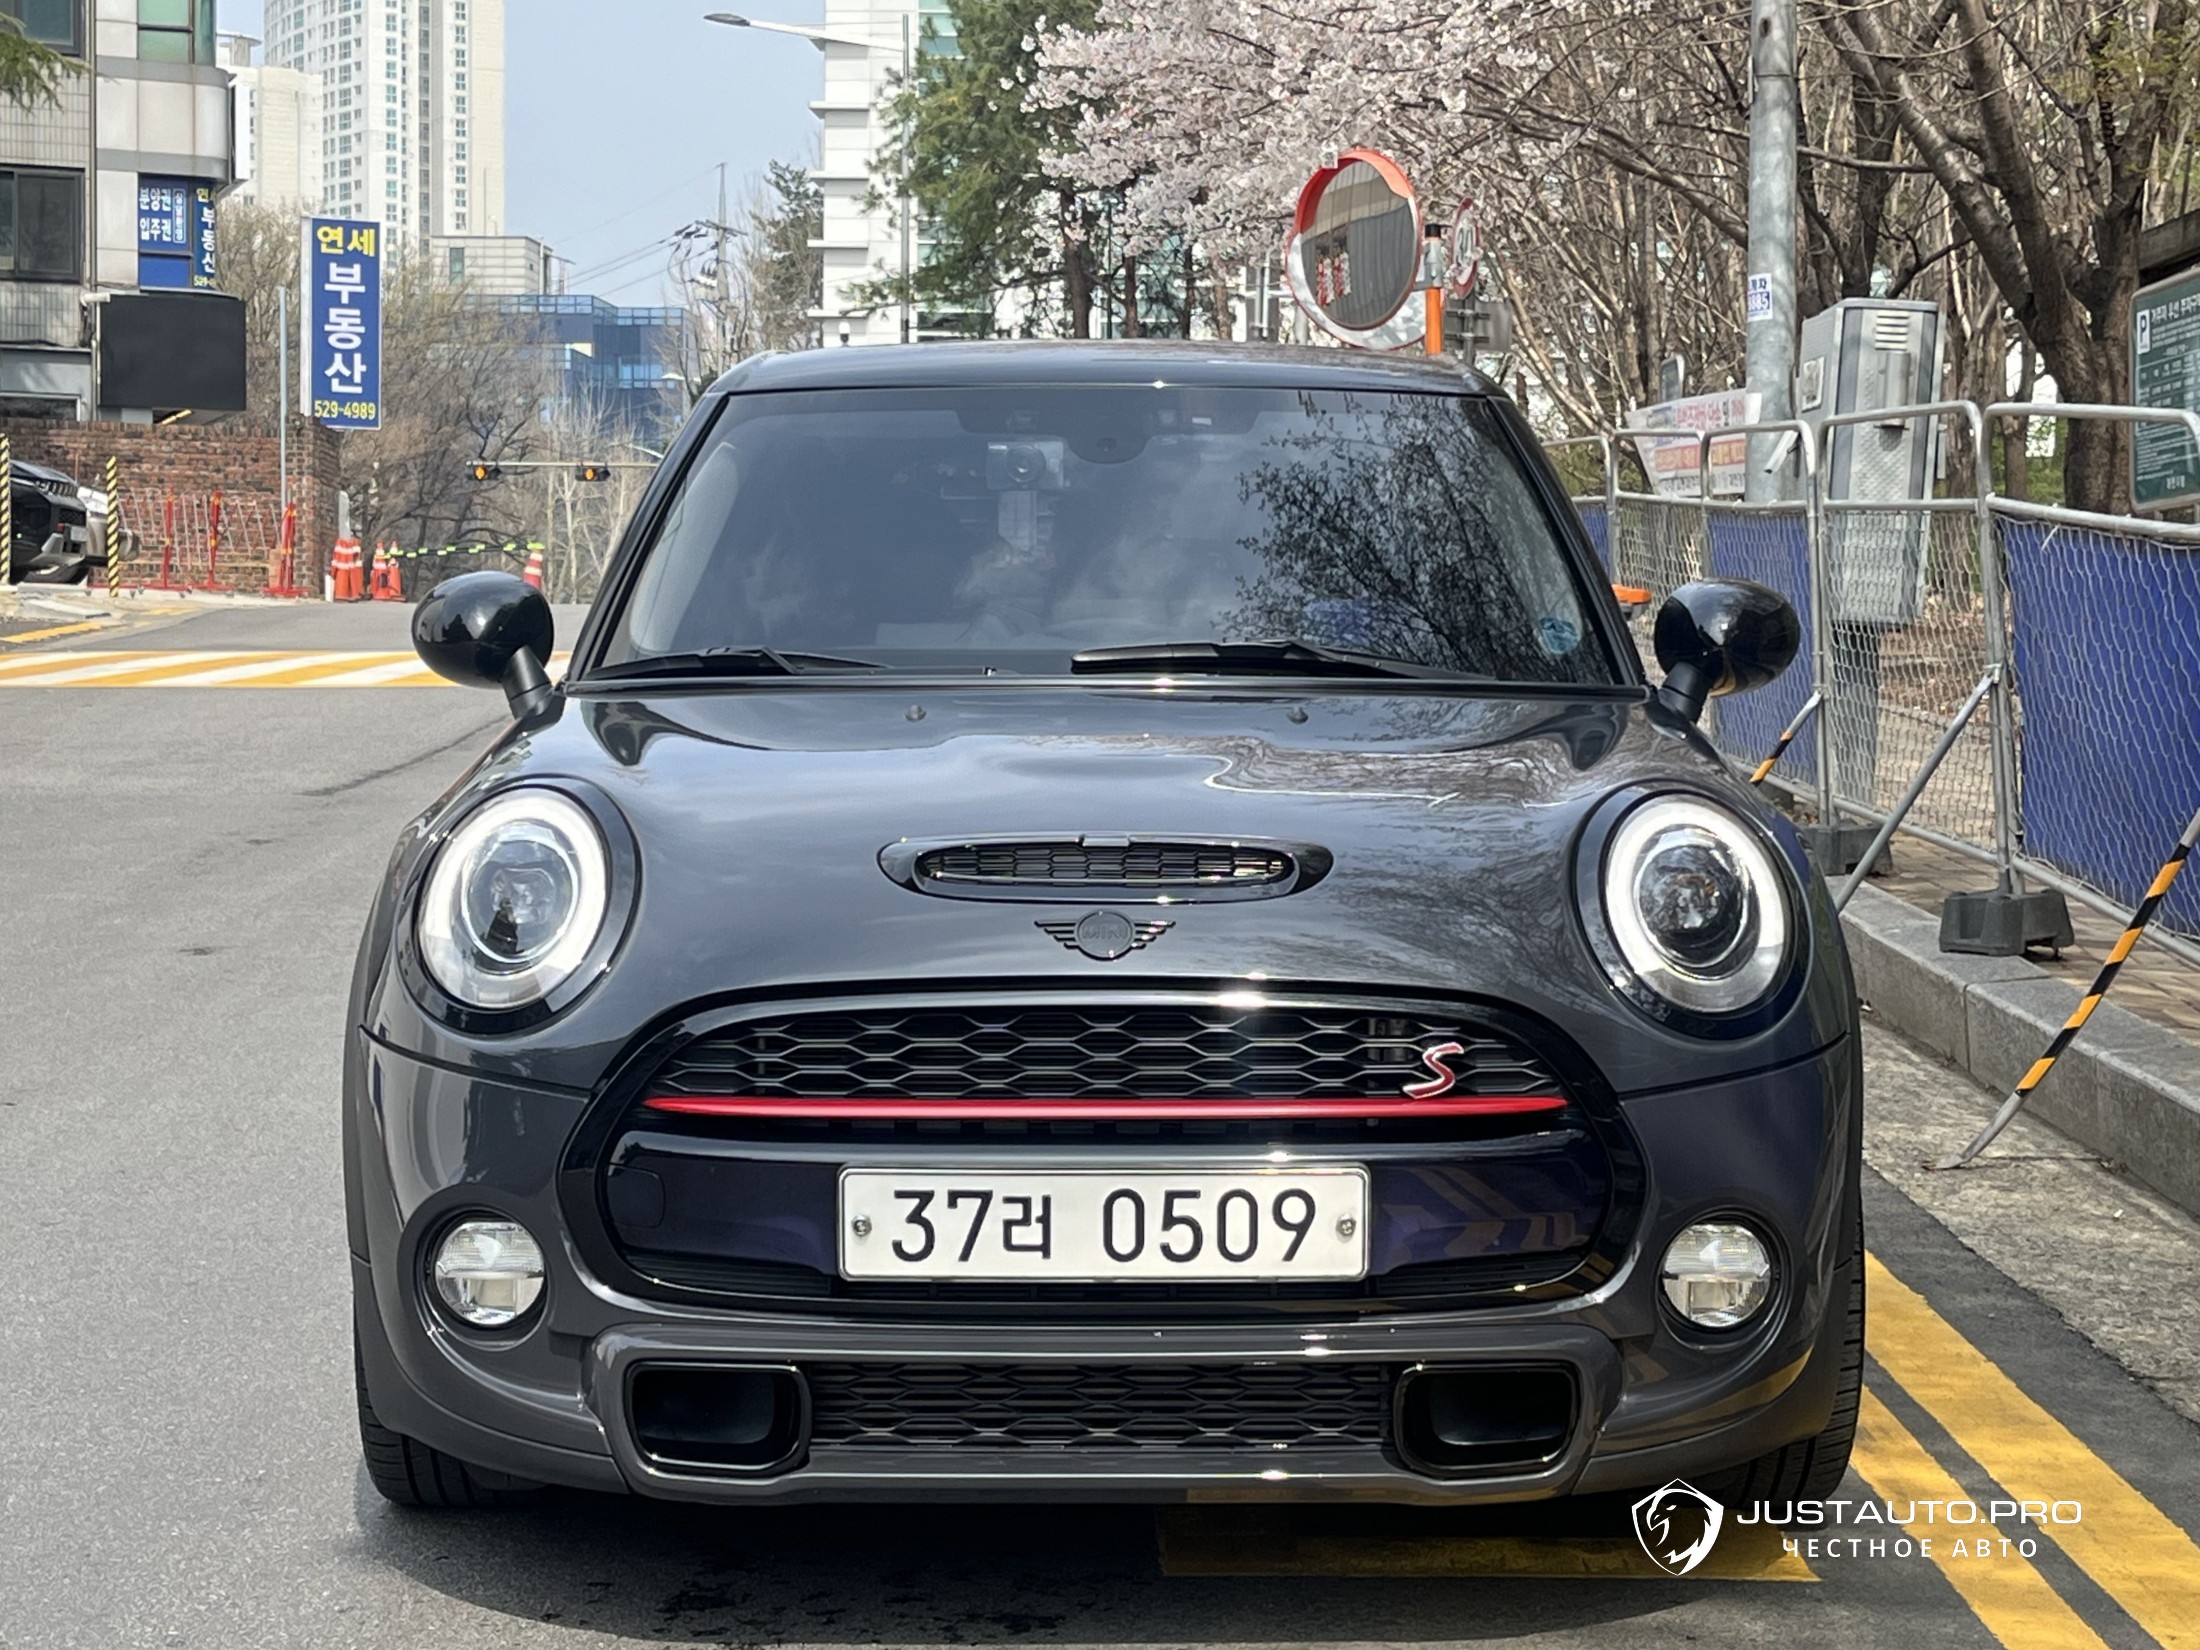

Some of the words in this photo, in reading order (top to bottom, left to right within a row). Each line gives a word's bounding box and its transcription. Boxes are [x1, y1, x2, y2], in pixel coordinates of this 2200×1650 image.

[139, 187, 171, 211] 분양권
[139, 217, 172, 242] 입주권
[316, 225, 376, 257] 연세
[323, 262, 367, 394] 부동산
[314, 400, 376, 420] 529-4989
[1082, 926, 1129, 939] MINI
[1402, 1042, 1464, 1099] S
[892, 1189, 1051, 1262] 37러
[1103, 1188, 1316, 1262] 0509
